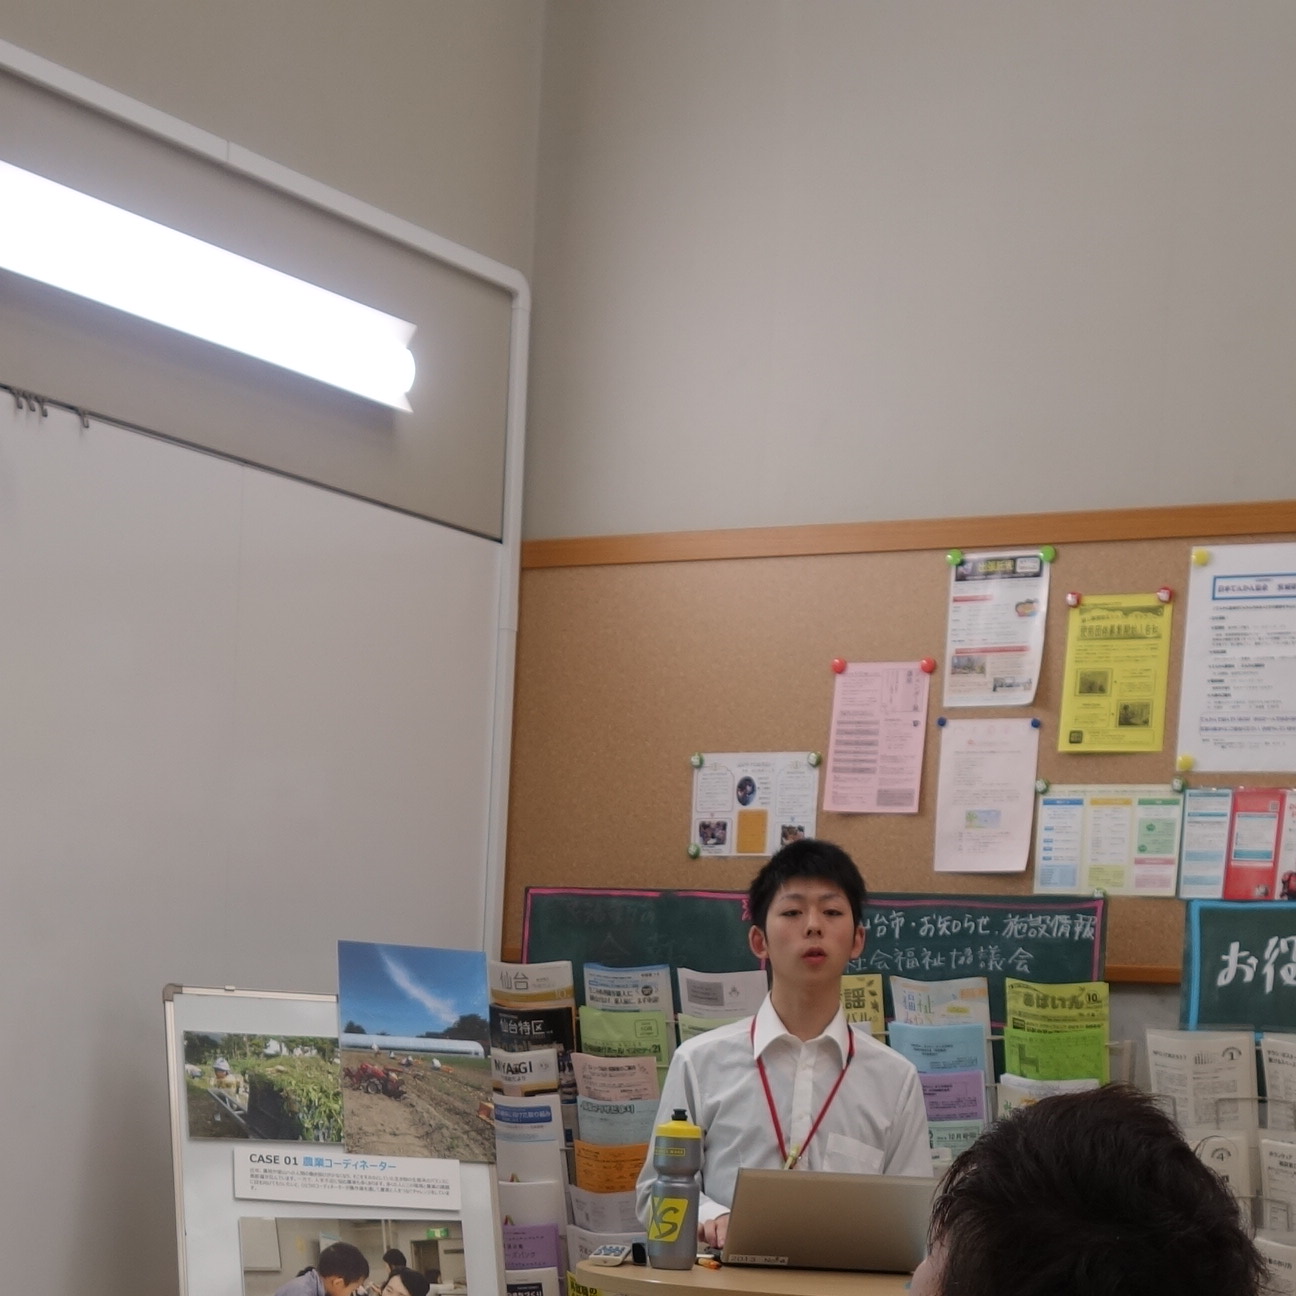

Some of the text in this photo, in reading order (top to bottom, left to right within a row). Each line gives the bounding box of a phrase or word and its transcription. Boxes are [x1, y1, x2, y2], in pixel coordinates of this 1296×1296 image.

[249, 1153, 397, 1171] CASE 01 農業コーディネーター
